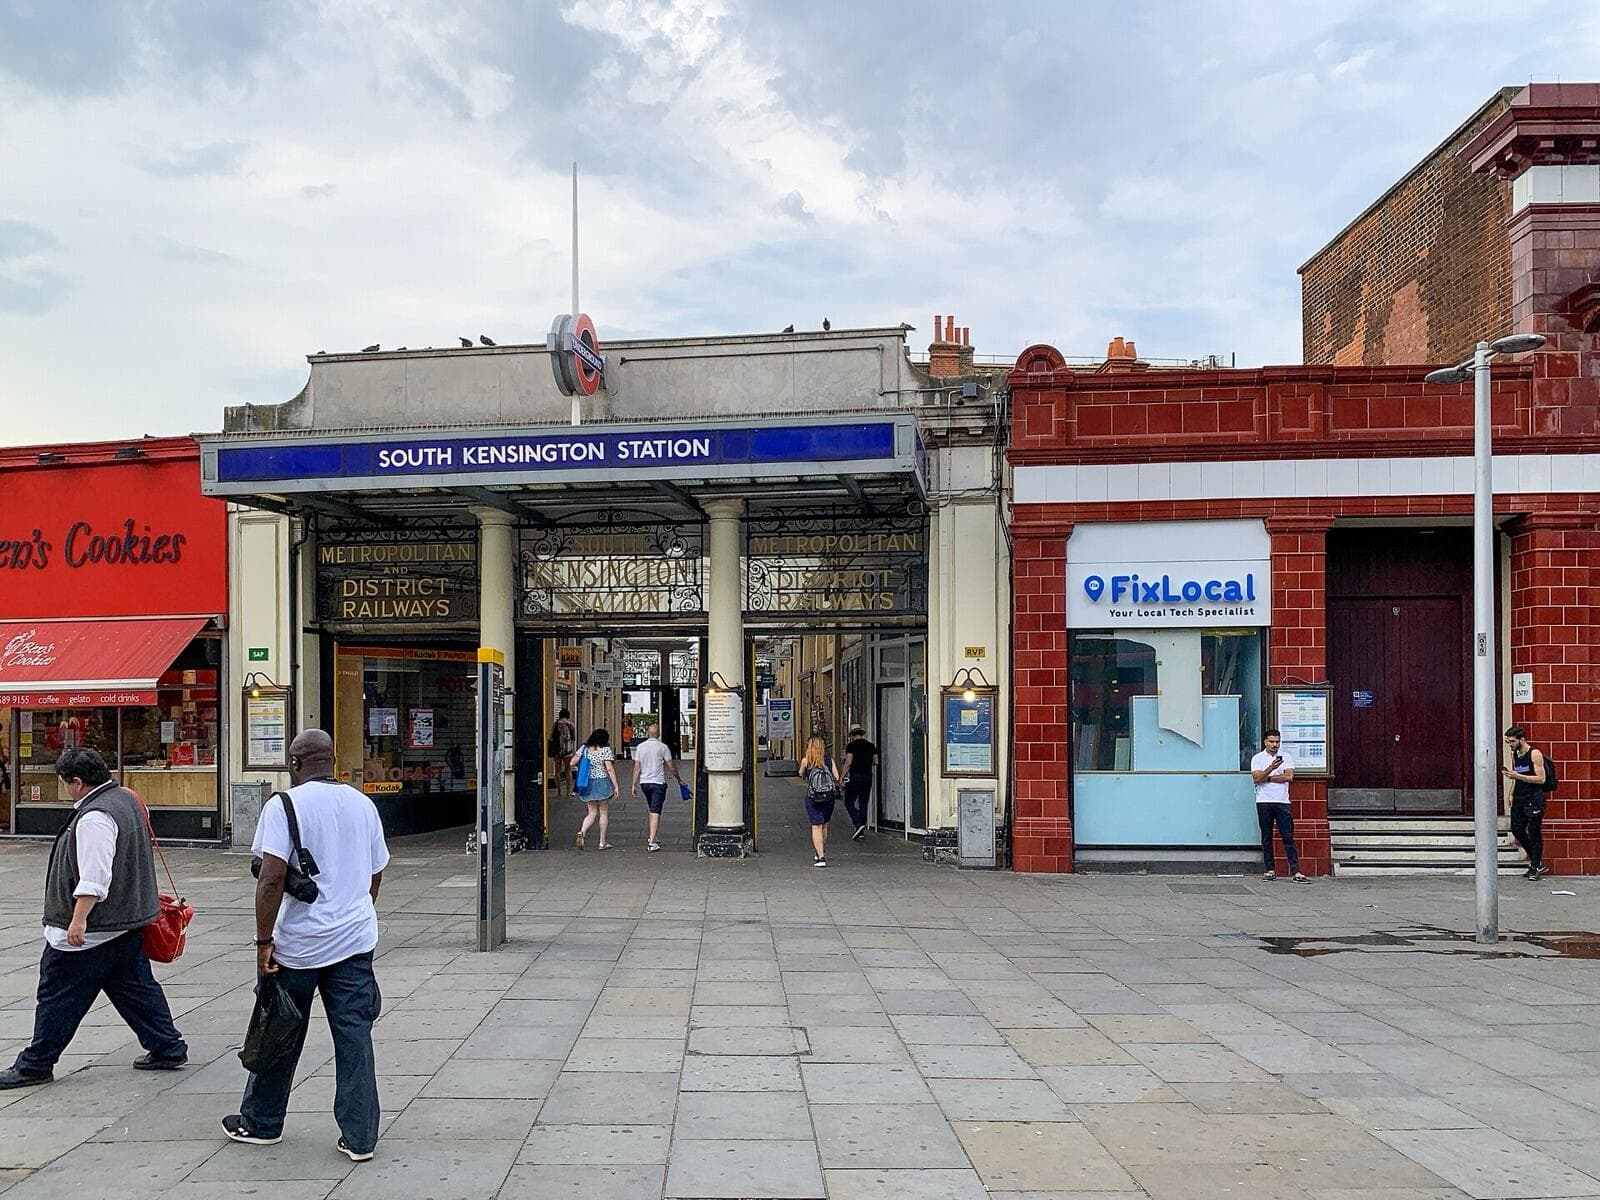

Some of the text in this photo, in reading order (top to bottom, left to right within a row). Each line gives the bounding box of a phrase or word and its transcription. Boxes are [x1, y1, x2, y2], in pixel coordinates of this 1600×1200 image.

[379, 439, 710, 467] SOUTH KENSINGTON STATION
[65, 518, 186, 568] Cookies
[753, 533, 917, 553] METROPOLITAN
[321, 545, 471, 564] METROPOLITAN
[383, 567, 409, 575] AND
[534, 559, 689, 588] KENSINGTON
[343, 578, 450, 597] DISTRICT
[1111, 573, 1256, 604] FixLocal
[343, 600, 450, 618] RAILWAYS
[560, 591, 661, 612] STATION
[1109, 607, 1255, 617] Your Local Tech Specialist
[966, 648, 984, 656] RVP
[12, 695, 30, 704] 9155
[38, 693, 140, 705] coffee gelato cold drinks
[375, 783, 401, 792] Kodak
